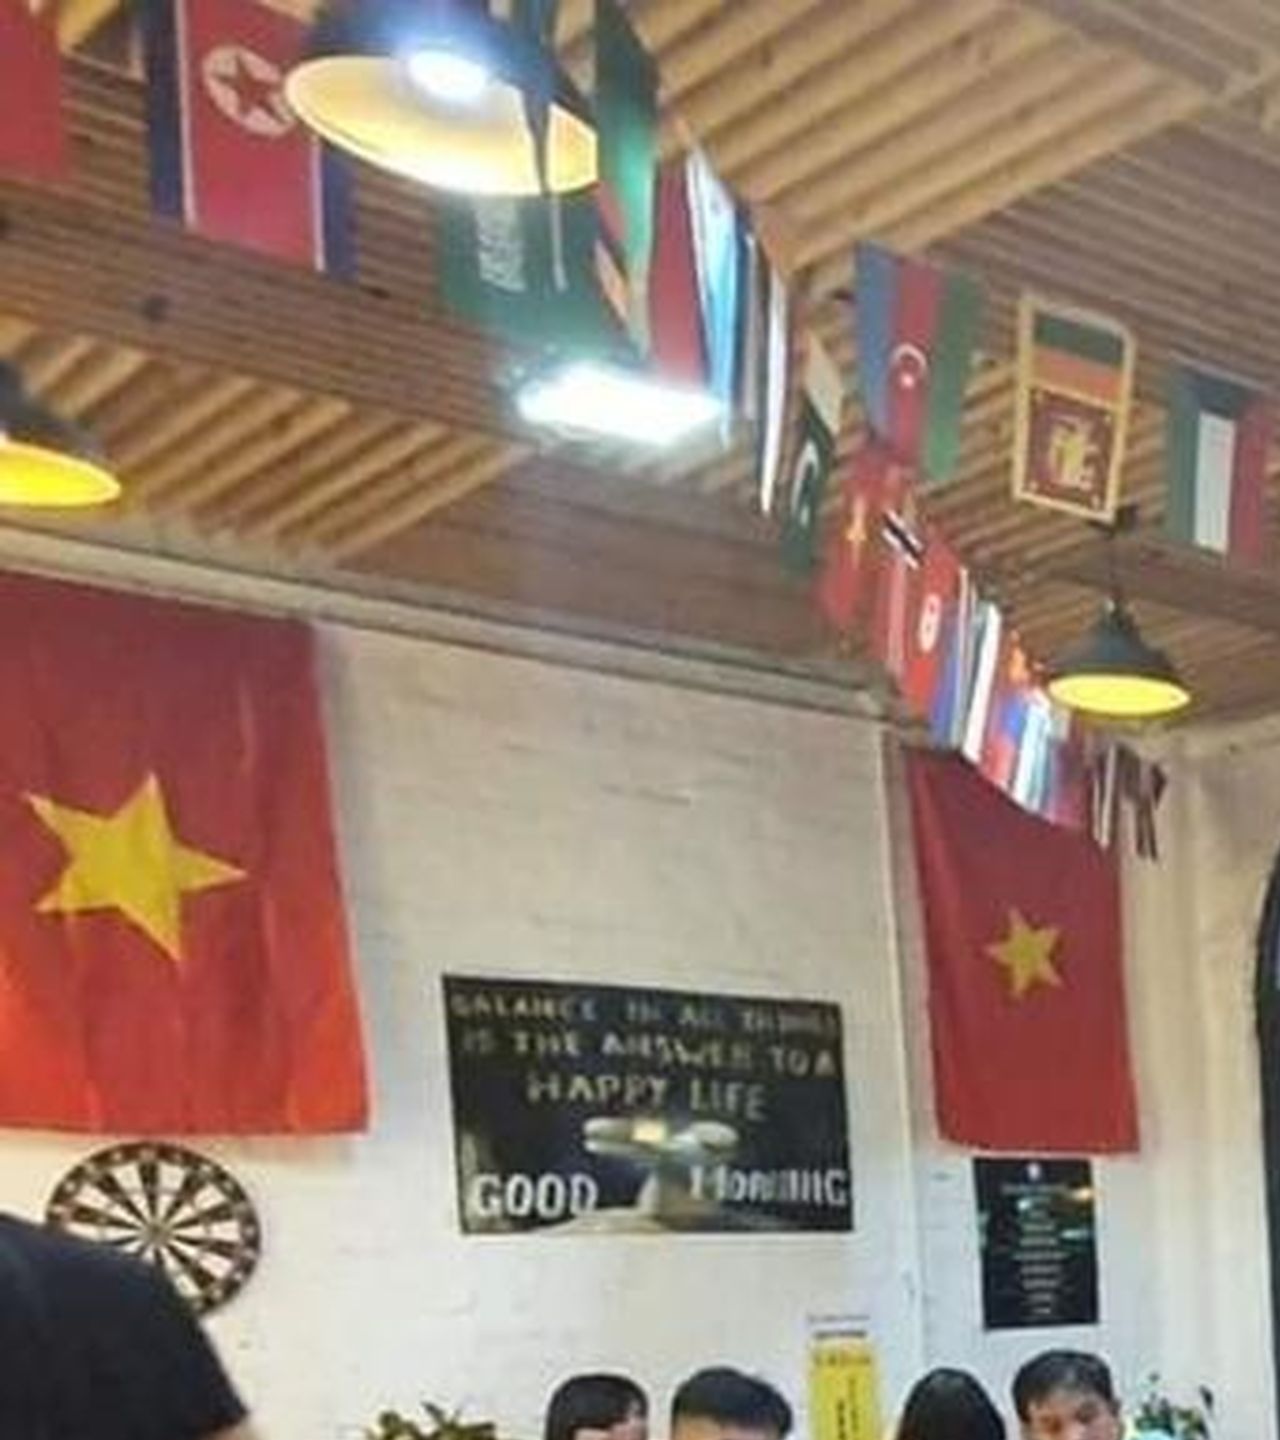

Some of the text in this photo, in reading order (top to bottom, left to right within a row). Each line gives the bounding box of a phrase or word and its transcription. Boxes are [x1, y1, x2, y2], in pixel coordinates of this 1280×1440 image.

[514, 1031, 581, 1057] THE
[526, 1070, 767, 1121] HAPPY LIFE
[476, 1172, 599, 1219] GOOD
